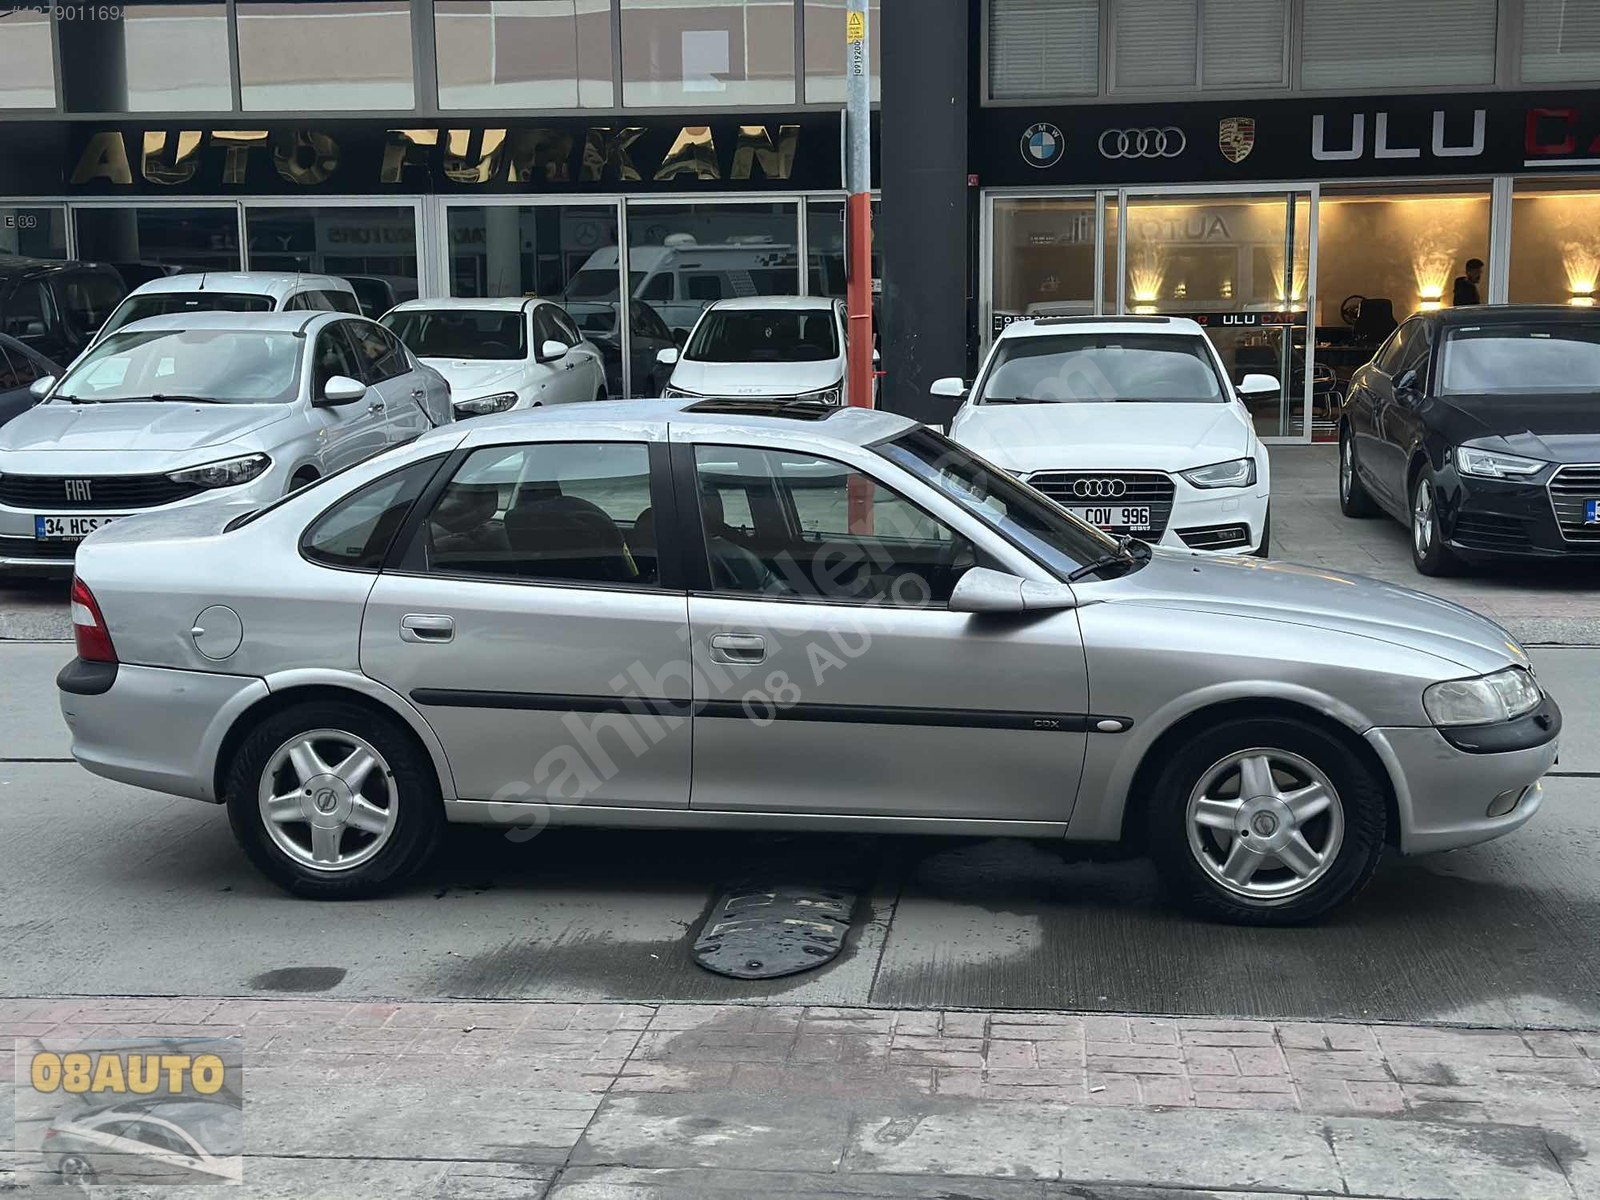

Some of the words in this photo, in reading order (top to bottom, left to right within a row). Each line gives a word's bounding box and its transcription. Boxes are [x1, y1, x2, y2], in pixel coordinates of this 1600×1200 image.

[1311, 109, 1487, 161] ULU
[1524, 108, 1600, 155] C
[70, 130, 340, 185] AUTO
[380, 126, 800, 184] FURKAN
[5, 215, 15, 228] E
[18, 215, 37, 228] 89
[1223, 315, 1255, 324] ULU
[1261, 314, 1296, 323] CAR
[65, 480, 92, 501] FIAT
[1085, 508, 1111, 524] COV
[1121, 508, 1149, 524] 996
[46, 518, 64, 534] 34
[70, 518, 98, 534] HCS
[1034, 720, 1060, 728] CDX
